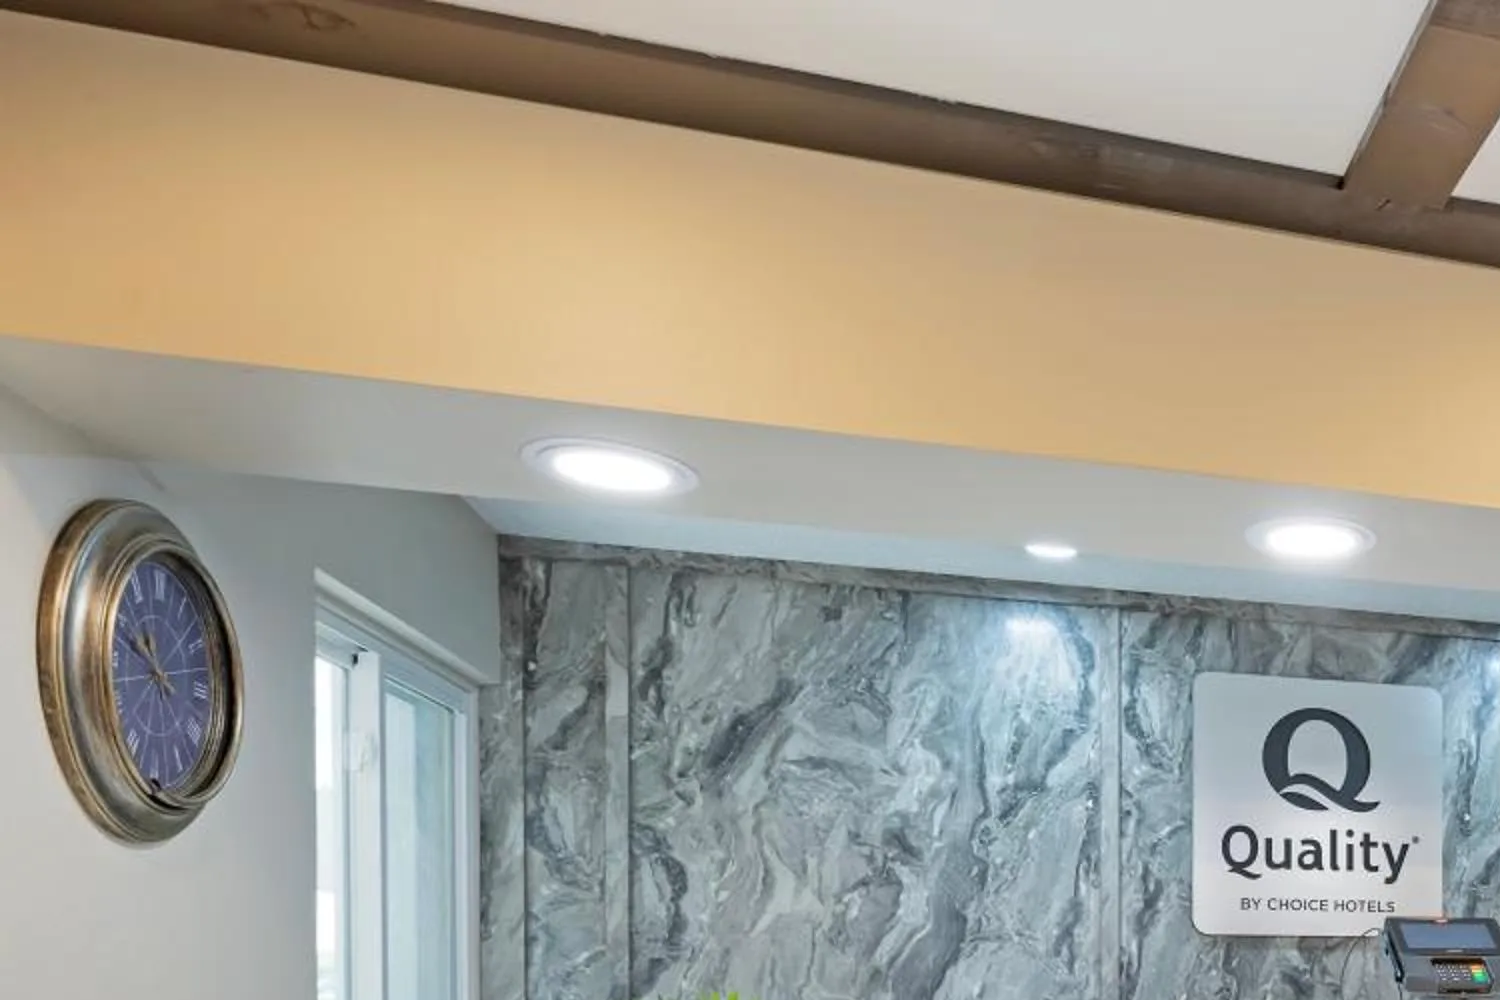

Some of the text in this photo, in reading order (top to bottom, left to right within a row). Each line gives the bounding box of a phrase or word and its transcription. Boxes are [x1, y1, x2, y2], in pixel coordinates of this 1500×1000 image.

[1262, 707, 1381, 812] Q
[1221, 825, 1410, 884] Quality
[1240, 897, 1396, 913] BY CHOICE HOTELS
